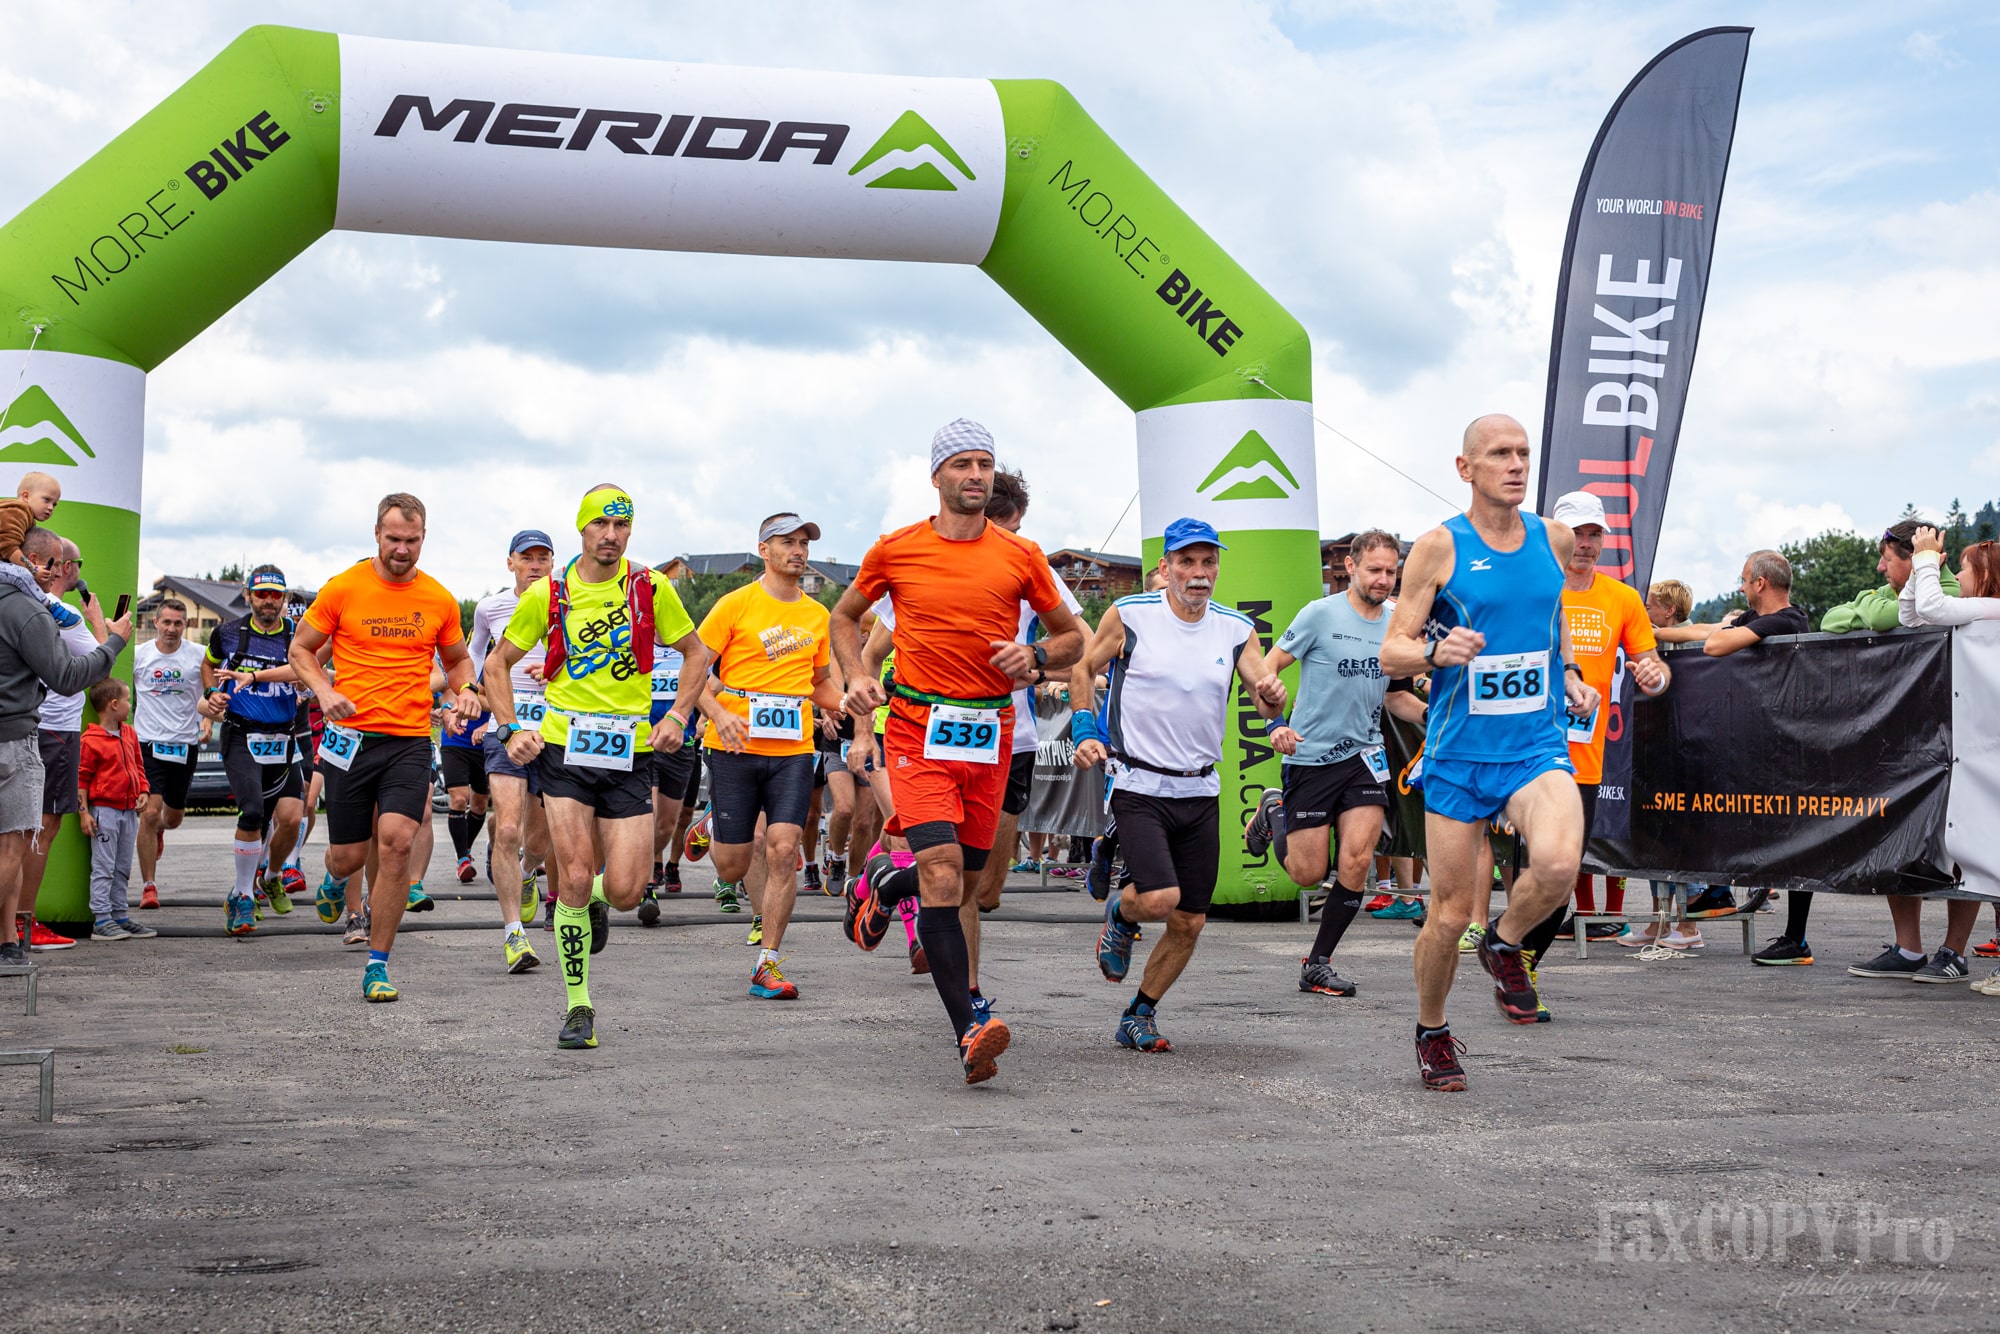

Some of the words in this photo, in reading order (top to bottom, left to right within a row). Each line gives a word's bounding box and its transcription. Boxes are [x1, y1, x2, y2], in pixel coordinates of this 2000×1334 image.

[374, 95, 850, 165] MERIDA
[184, 110, 290, 201] BIKE
[1597, 198, 1624, 214] YOUR
[1626, 199, 1662, 215] WORLD
[1663, 200, 1678, 216] ON
[1678, 202, 1704, 220] BIKE
[1156, 268, 1244, 357] BIKE
[770, 629, 792, 645] ONCE
[774, 635, 797, 650] LOVE
[775, 636, 814, 658] FOREVER
[1337, 656, 1379, 669] RETR
[652, 678, 679, 692] 526
[1337, 668, 1370, 679] RUNNING
[1371, 668, 1385, 680] TEA
[1480, 668, 1541, 700] 568
[756, 707, 796, 729] 601
[574, 730, 627, 757] 529
[934, 720, 993, 748] 539
[1237, 601, 1275, 869] MDA.cm
[156, 743, 185, 756] 531
[253, 741, 283, 756] 524
[1692, 793, 1790, 815] ARCHITEKTI
[1798, 796, 1890, 817] PREPRAVY
[560, 924, 590, 986] eleven
